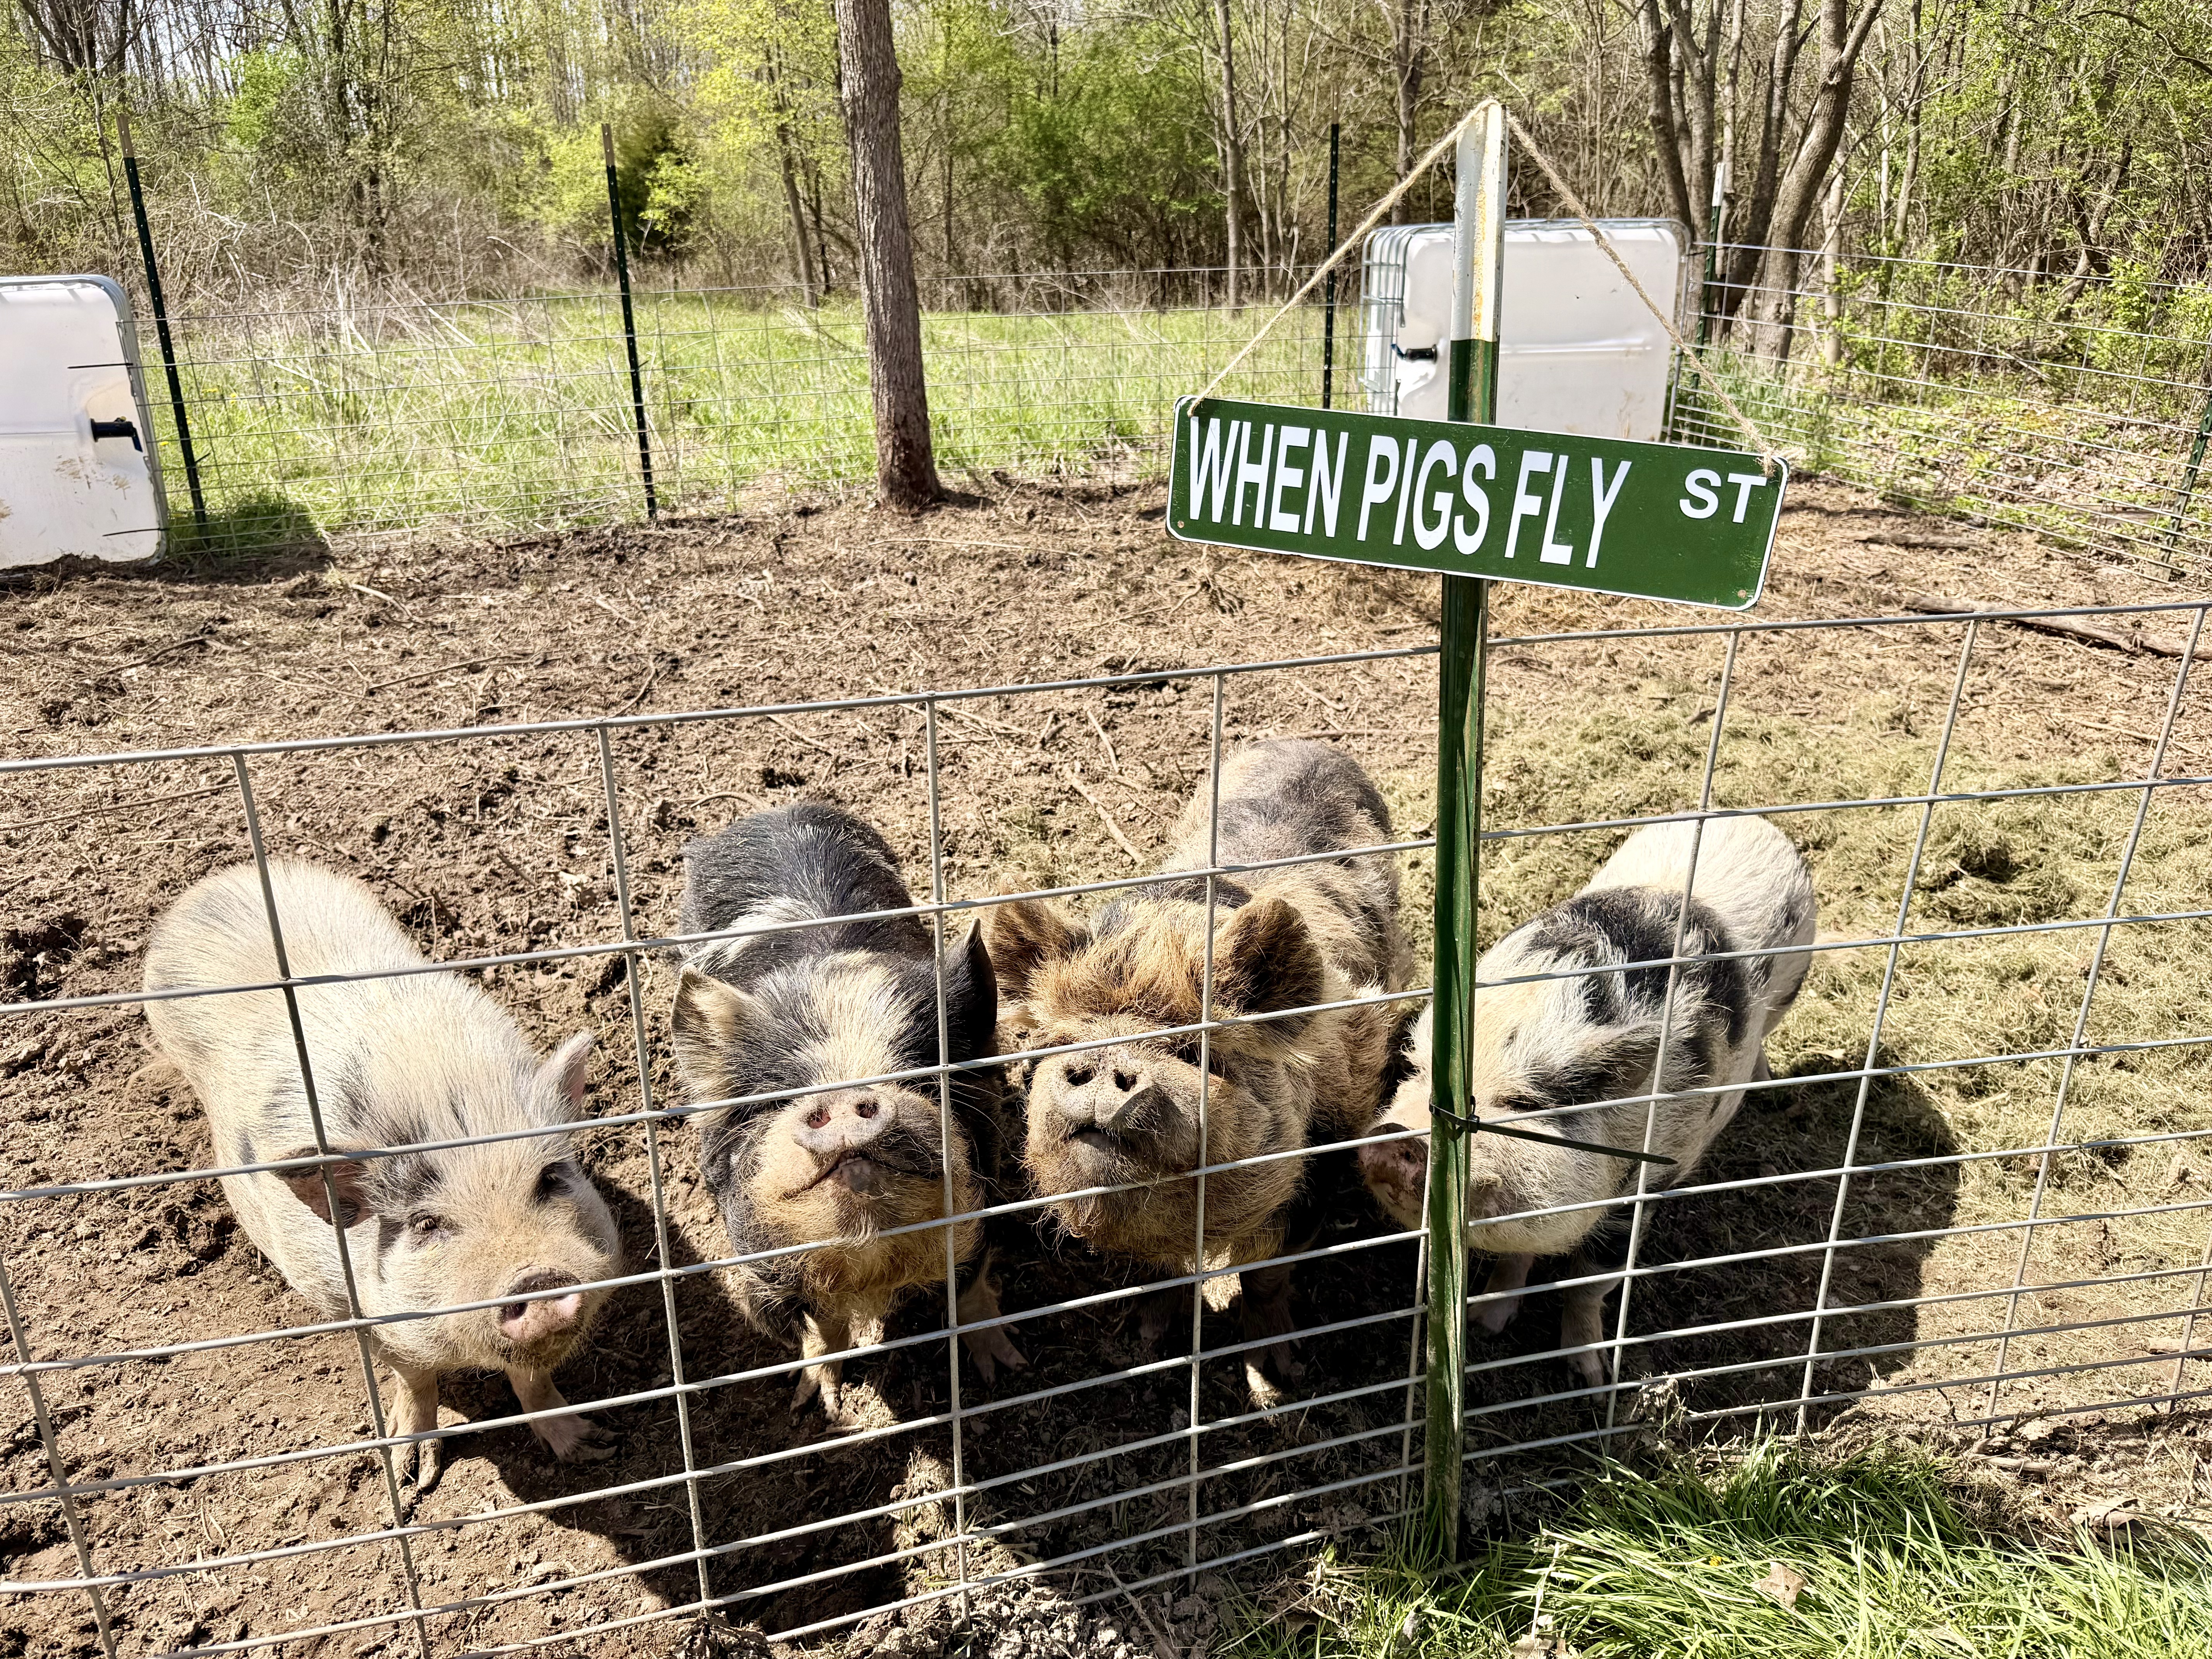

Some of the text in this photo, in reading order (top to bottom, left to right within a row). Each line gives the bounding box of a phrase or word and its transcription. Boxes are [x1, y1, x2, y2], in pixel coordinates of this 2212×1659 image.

[1190, 416, 1767, 568] WHEN PIGS FLY ST
